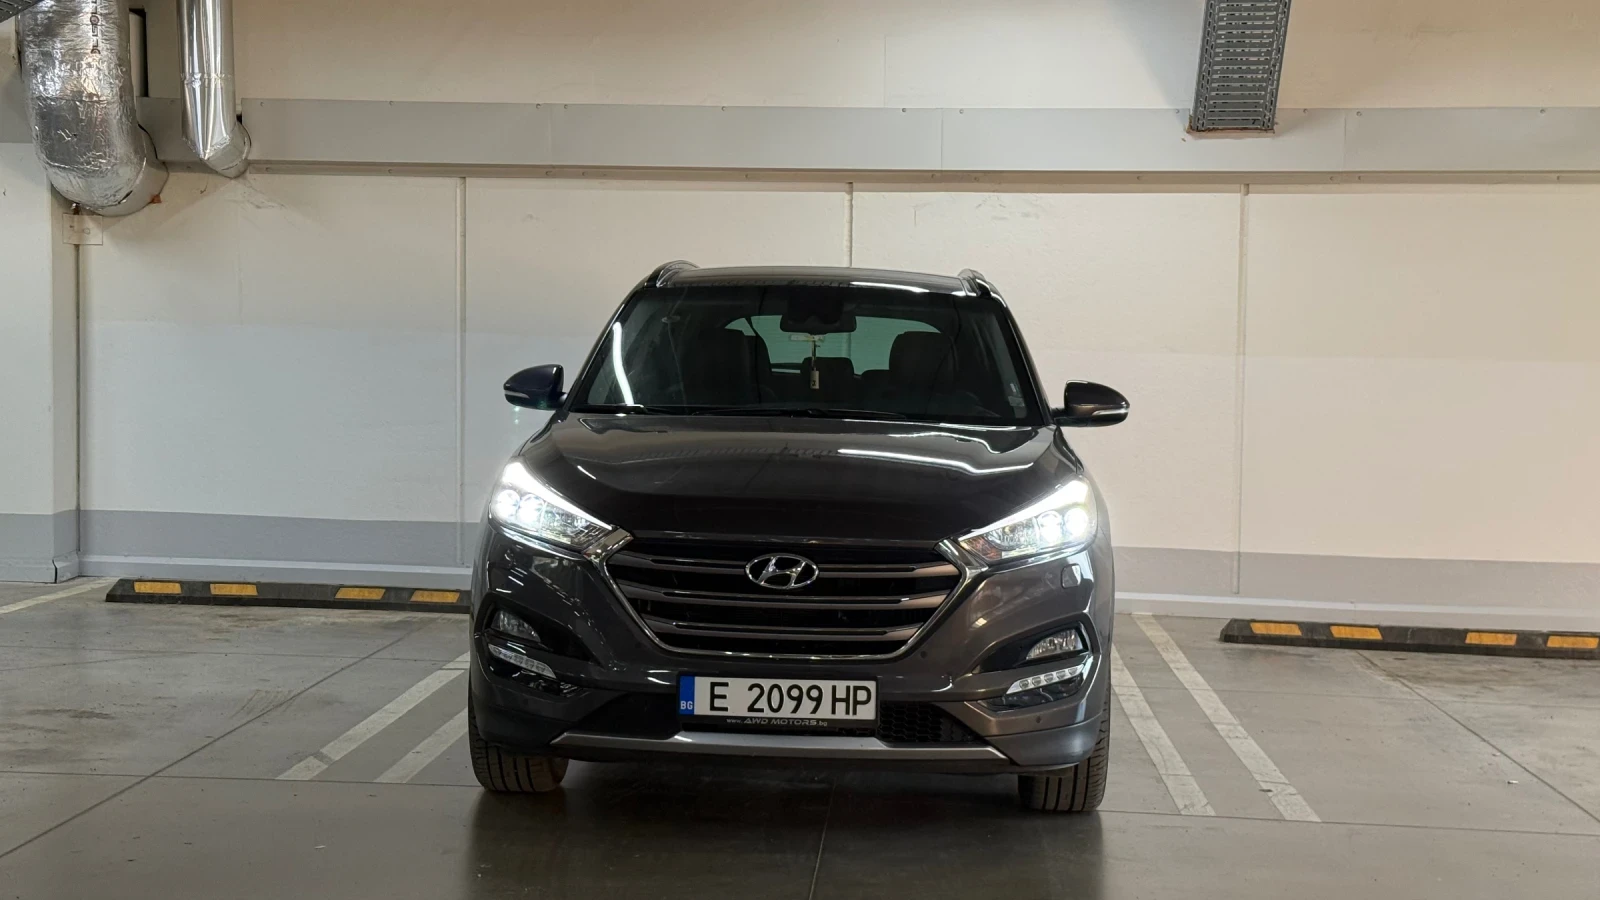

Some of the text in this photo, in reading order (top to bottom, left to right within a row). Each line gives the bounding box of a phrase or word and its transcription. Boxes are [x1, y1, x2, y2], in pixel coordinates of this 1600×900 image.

[680, 700, 693, 710] BG
[709, 681, 872, 716] E 2099 HP
